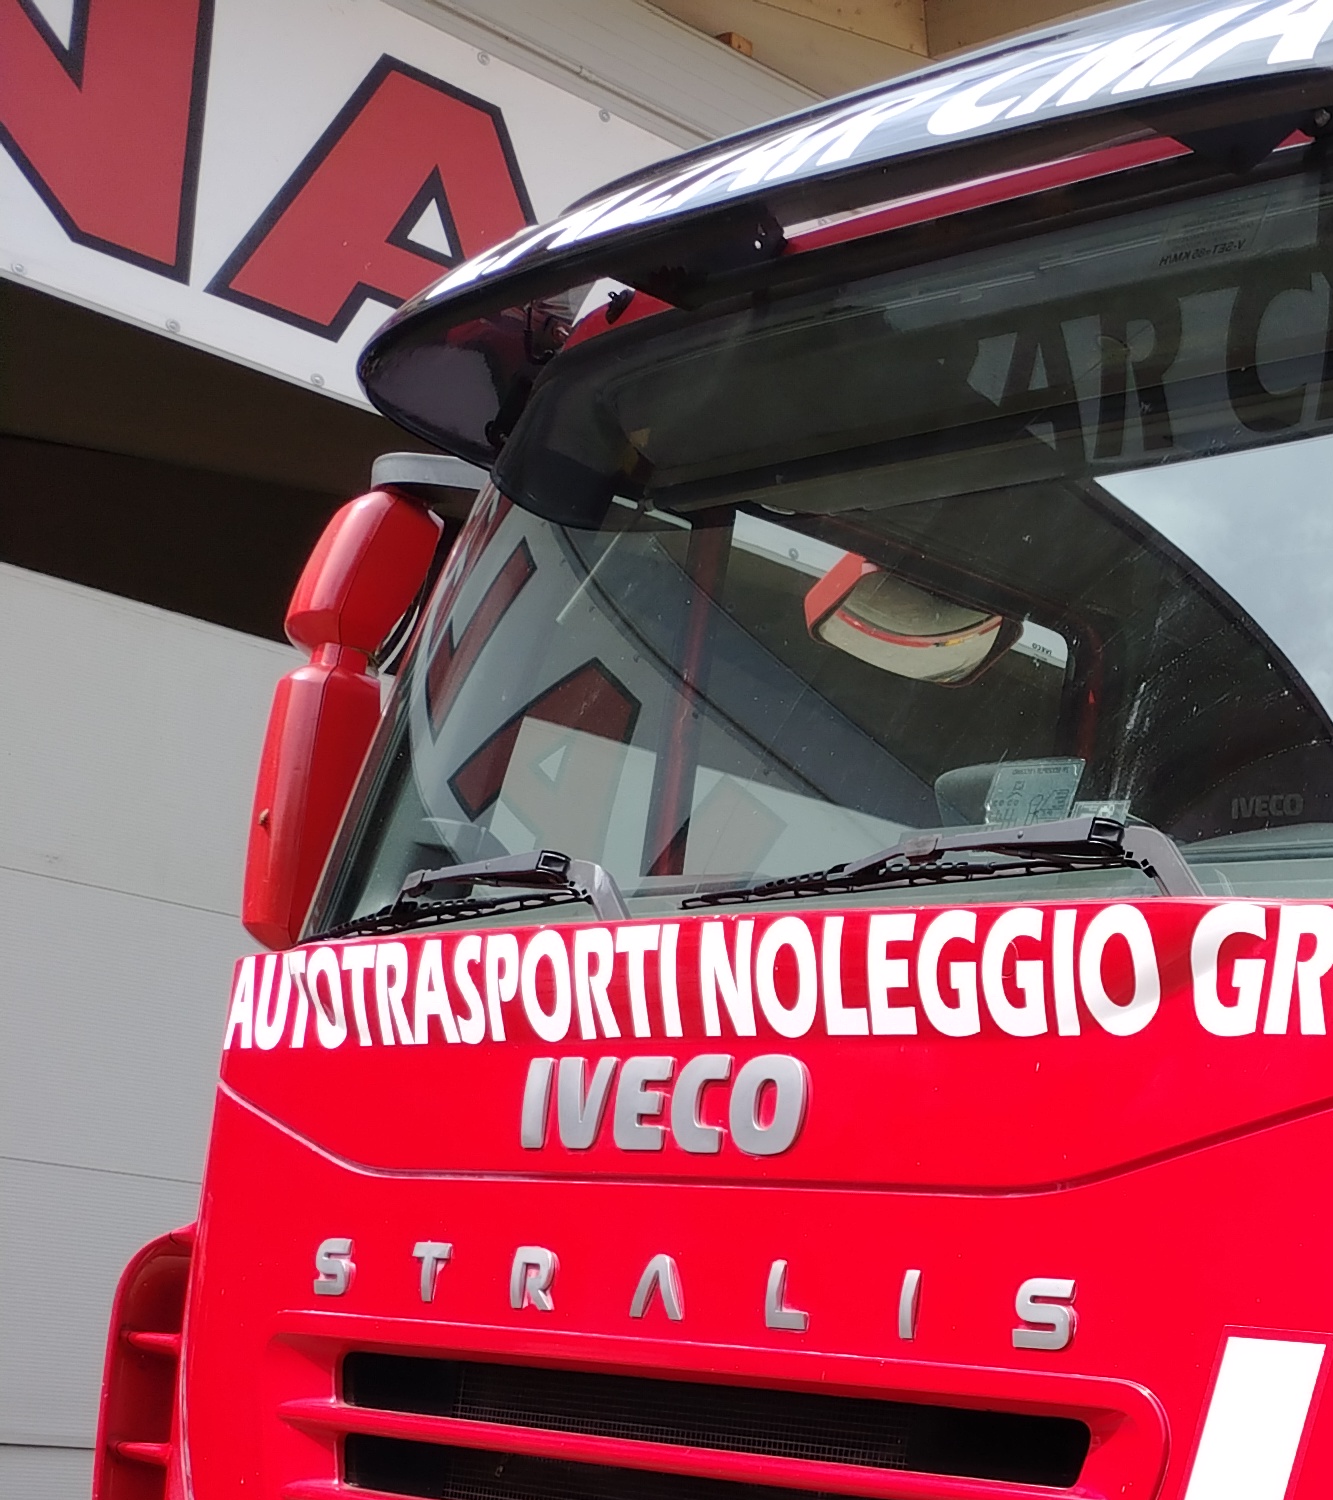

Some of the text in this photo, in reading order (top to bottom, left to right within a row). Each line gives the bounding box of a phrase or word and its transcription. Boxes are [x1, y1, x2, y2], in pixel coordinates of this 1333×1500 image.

[1231, 793, 1304, 820] IVECO
[223, 923, 683, 1050] AUTOTRASPORTI
[700, 903, 1162, 1038] NOLEGGIO
[519, 1053, 808, 1156] IVECO
[313, 1237, 1078, 1350] STRALIS
